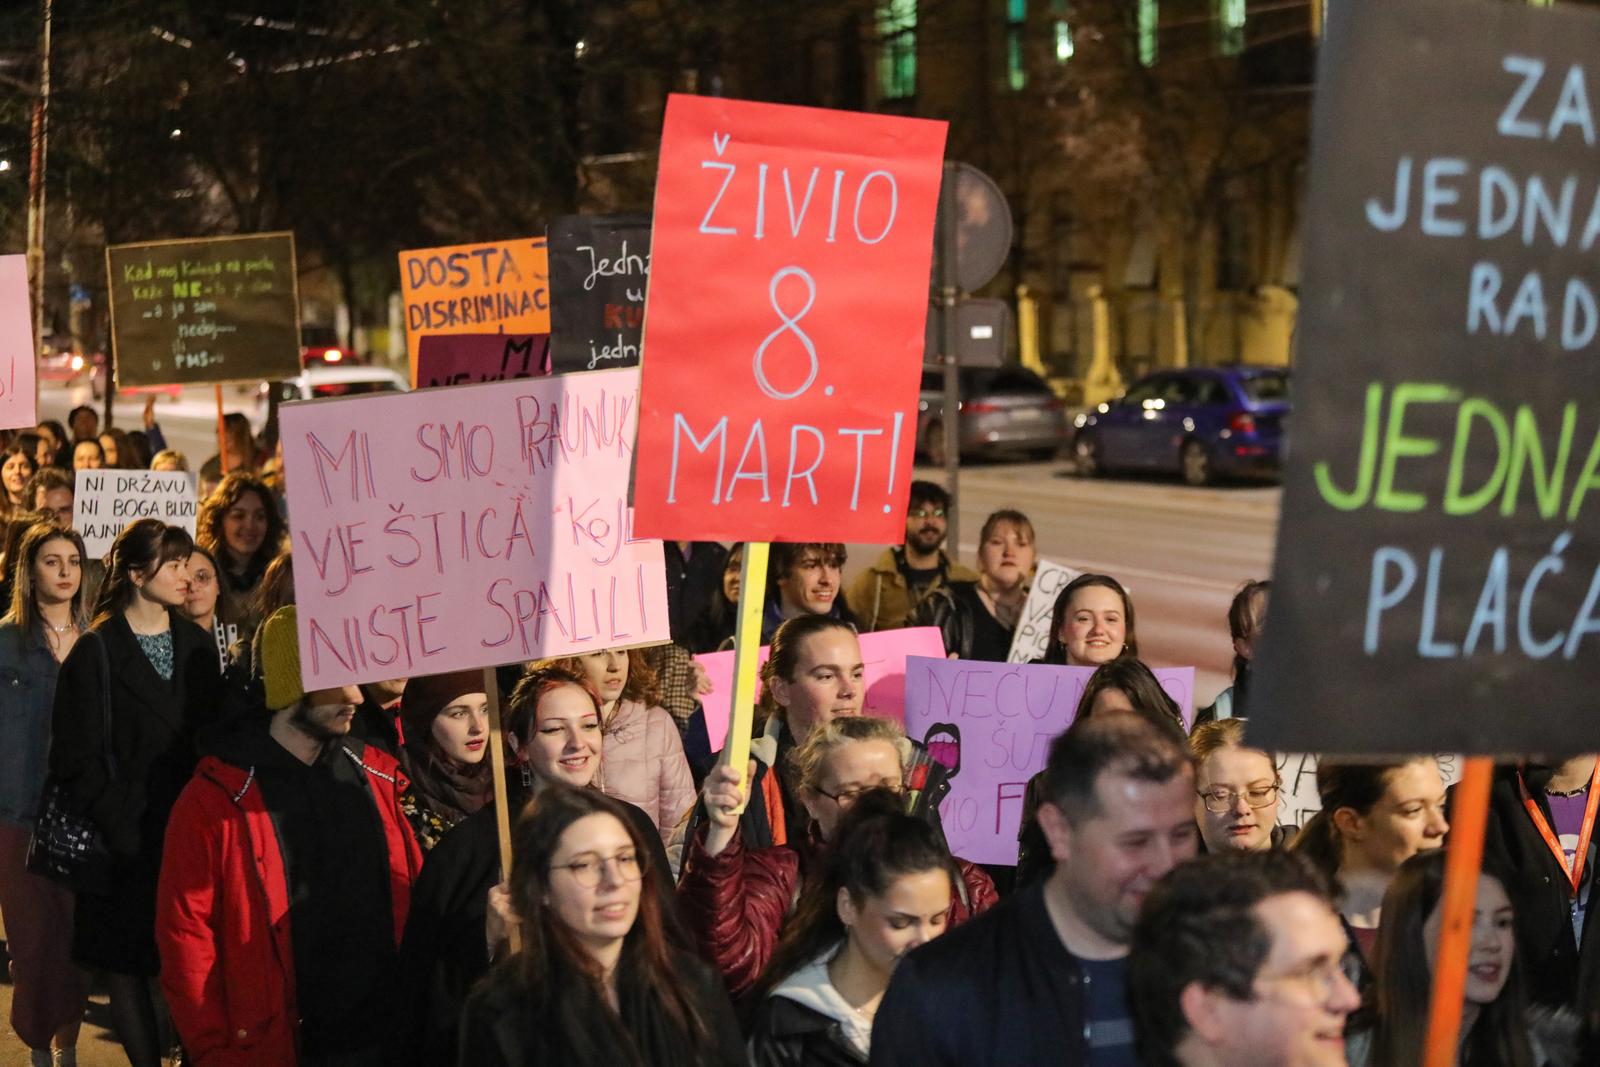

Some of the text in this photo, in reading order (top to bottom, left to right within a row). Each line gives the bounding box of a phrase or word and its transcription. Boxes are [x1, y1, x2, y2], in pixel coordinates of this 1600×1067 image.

[1498, 56, 1596, 146] ZA
[700, 132, 898, 244] ŽIVIO
[173, 281, 201, 299] NE
[408, 249, 521, 289] DOSTA
[409, 289, 548, 331] DISKRIMINAC
[1467, 262, 1599, 350] RAD
[753, 266, 835, 400] 8.
[86, 474, 185, 494] NI DRŽAVU
[306, 430, 376, 507] MI
[410, 421, 494, 482] SMO
[667, 412, 904, 514] MART!
[81, 499, 196, 517] NI BOGA BLIZU
[310, 564, 648, 676] NISTE SPALILI
[920, 666, 1059, 720] NEĆU
